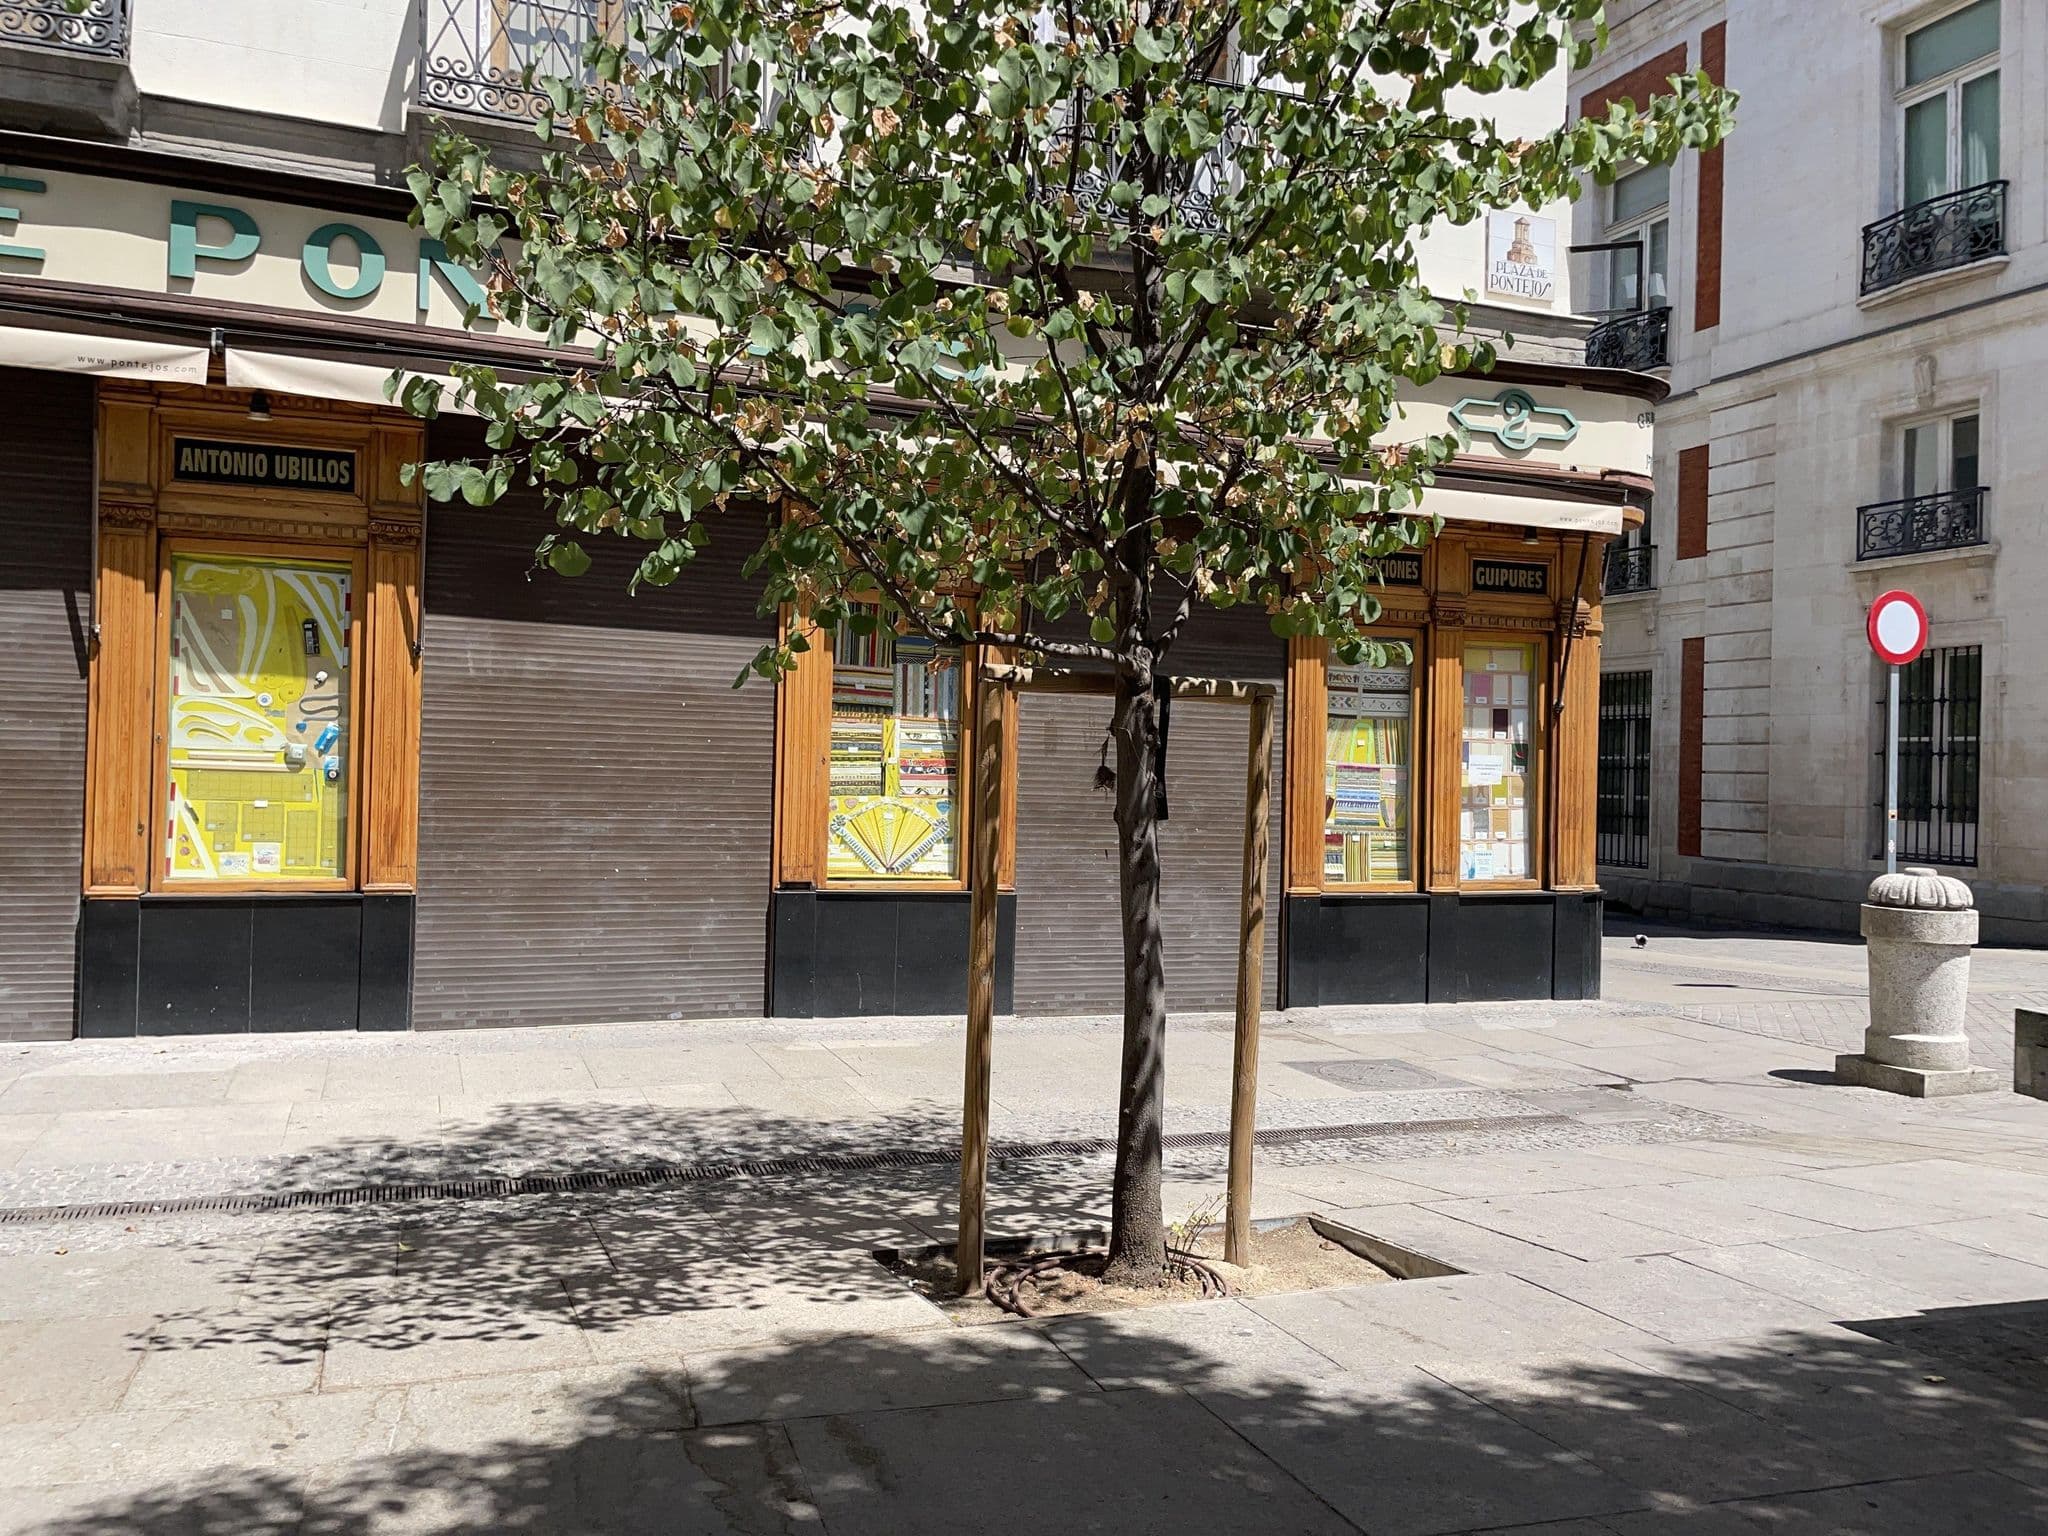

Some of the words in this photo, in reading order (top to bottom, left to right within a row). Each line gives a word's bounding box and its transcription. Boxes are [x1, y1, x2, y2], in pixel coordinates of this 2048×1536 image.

[1495, 261, 1534, 278] PLAZA
[1536, 268, 1548, 279] DE
[1490, 274, 1552, 297] PONTEJOS
[1503, 393, 1529, 444] 2
[179, 447, 268, 478] ANTONIO
[274, 454, 350, 485] UBILLOS
[1475, 566, 1543, 589] GUIPURES
